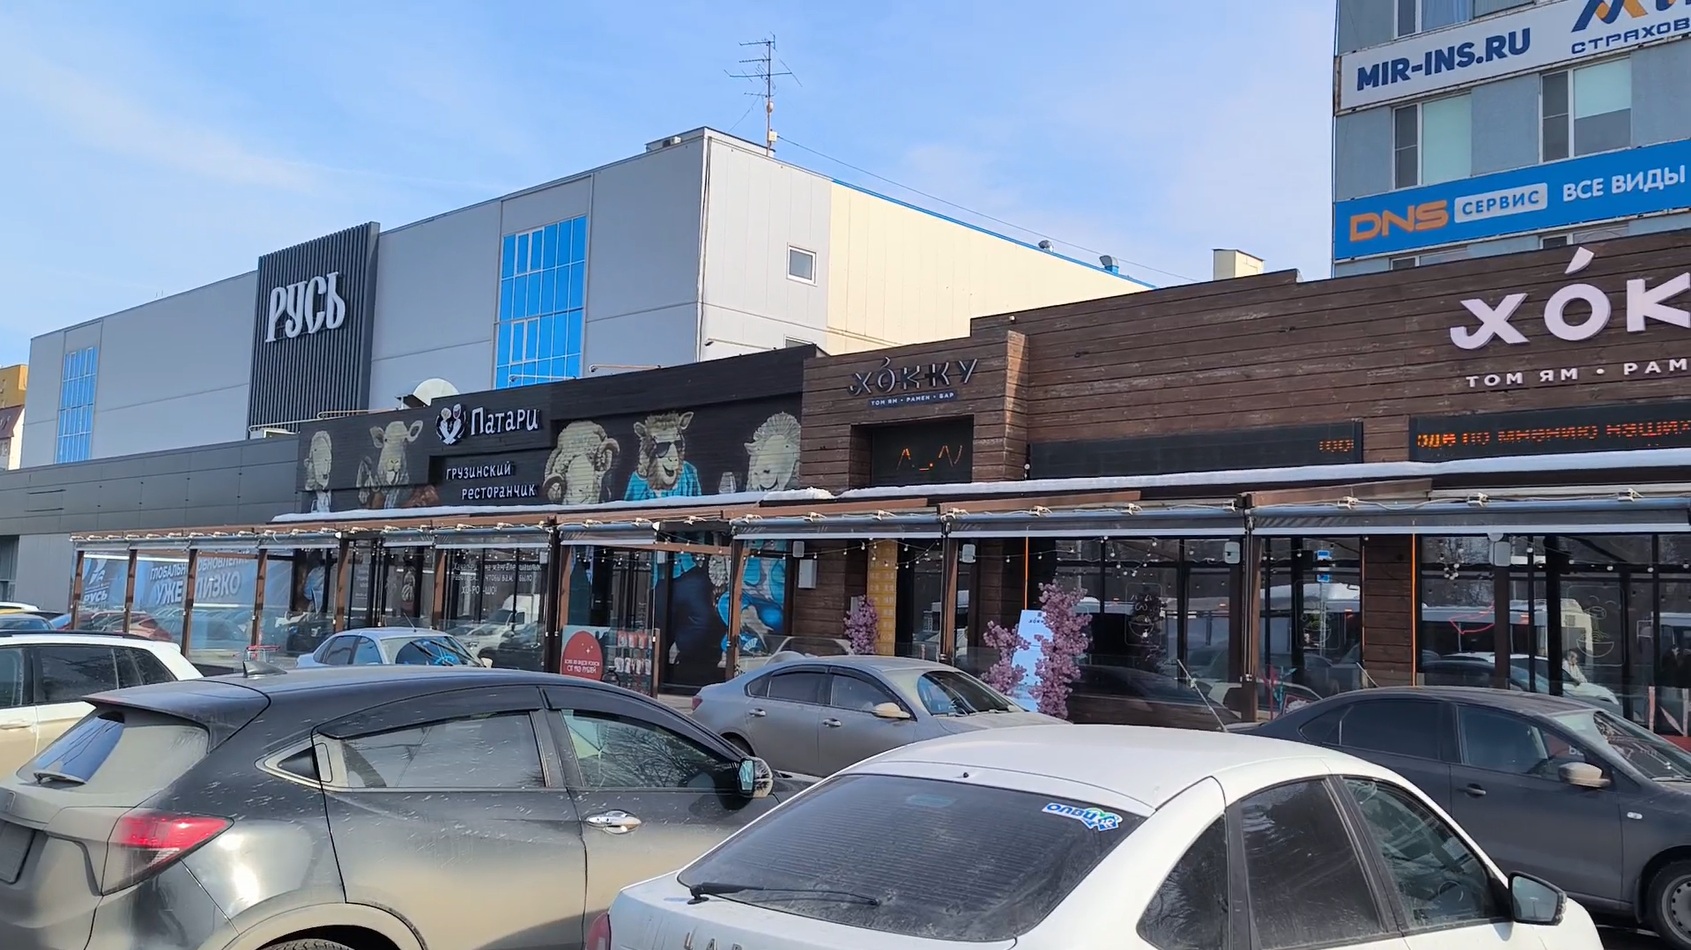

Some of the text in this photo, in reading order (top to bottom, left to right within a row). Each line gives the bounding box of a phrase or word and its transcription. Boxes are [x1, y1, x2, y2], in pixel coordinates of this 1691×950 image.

[1571, 17, 1690, 54] СТРАХОВ
[1357, 27, 1531, 91] MIR-INS.RU
[1563, 165, 1686, 201] ВСЕ ВИДЫ
[1350, 199, 1449, 242] DNS
[1462, 190, 1540, 215] СЕРВИС
[265, 271, 346, 342] РУСЬ
[1466, 358, 1687, 387] ТОМ ЯМ РАМ
[155, 570, 241, 605] УЖЕ ЛИЗКО
